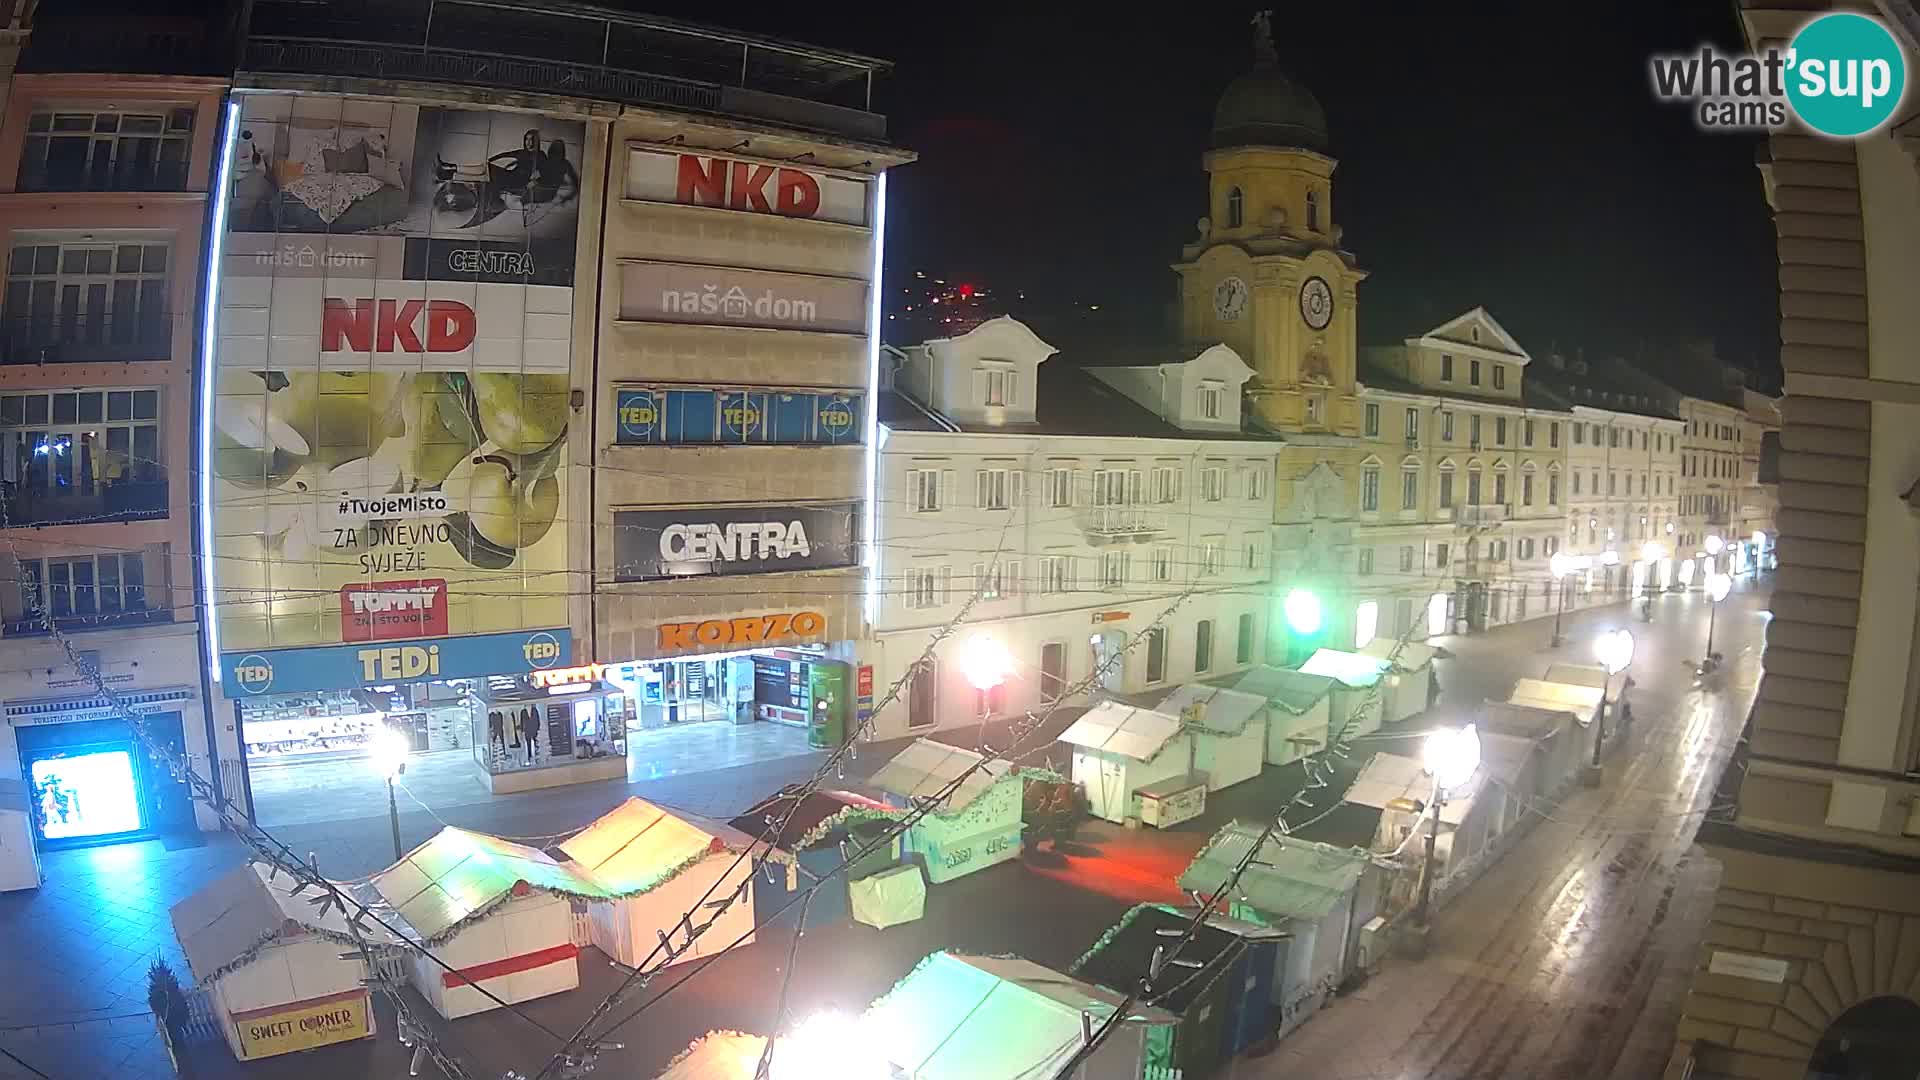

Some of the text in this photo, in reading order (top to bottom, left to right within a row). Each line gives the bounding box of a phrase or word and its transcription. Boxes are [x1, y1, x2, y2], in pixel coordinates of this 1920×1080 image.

[677, 154, 821, 218] NKD
[255, 244, 365, 267] naš dom
[449, 249, 535, 275] CENTRA
[662, 283, 816, 322] naš dom
[320, 297, 477, 353] NKD
[339, 496, 447, 516] #TvojeMisto
[333, 523, 451, 548] ZA DNEVNO
[659, 520, 811, 562] CENTRA
[359, 546, 426, 574] SVJEŽE
[349, 586, 439, 613] TOMMY
[658, 611, 825, 650] KORZO
[357, 645, 440, 682] TEDi
[523, 641, 560, 660] TEDi
[234, 664, 273, 681] TEDi
[250, 1020, 293, 1041] SWEET
[299, 1008, 352, 1032] CORNER
